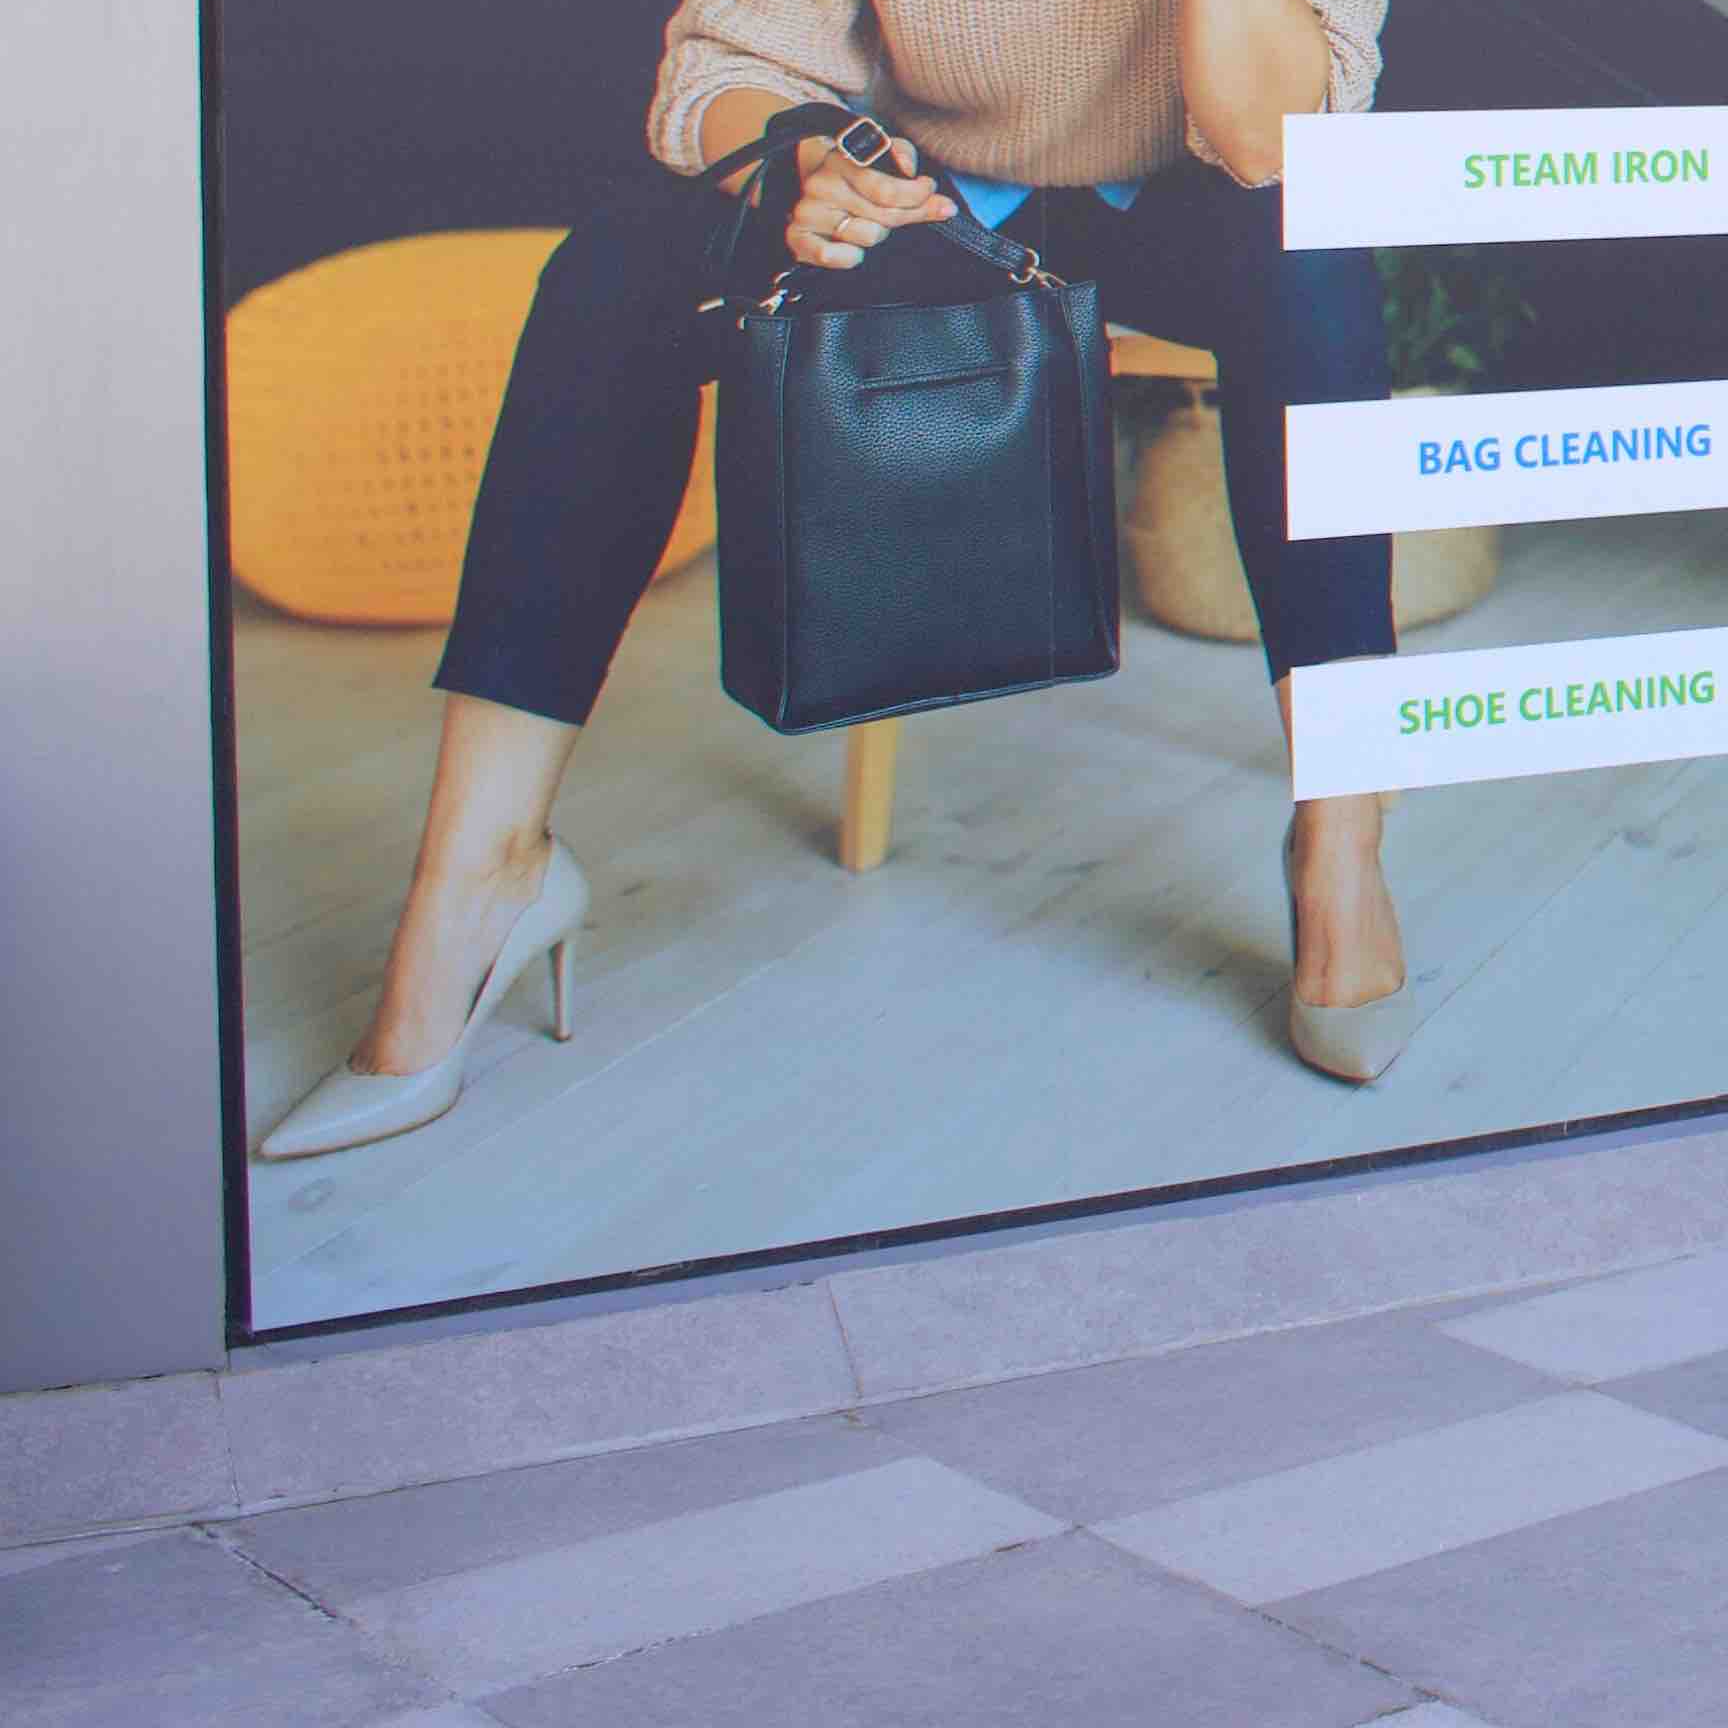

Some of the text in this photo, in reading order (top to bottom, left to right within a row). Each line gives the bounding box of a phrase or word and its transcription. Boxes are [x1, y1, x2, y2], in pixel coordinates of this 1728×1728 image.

[1463, 148, 1711, 190] STEAM IRON
[1418, 424, 1712, 476] BAG CLEANING
[1398, 670, 1716, 736] SHOE CLEANING
